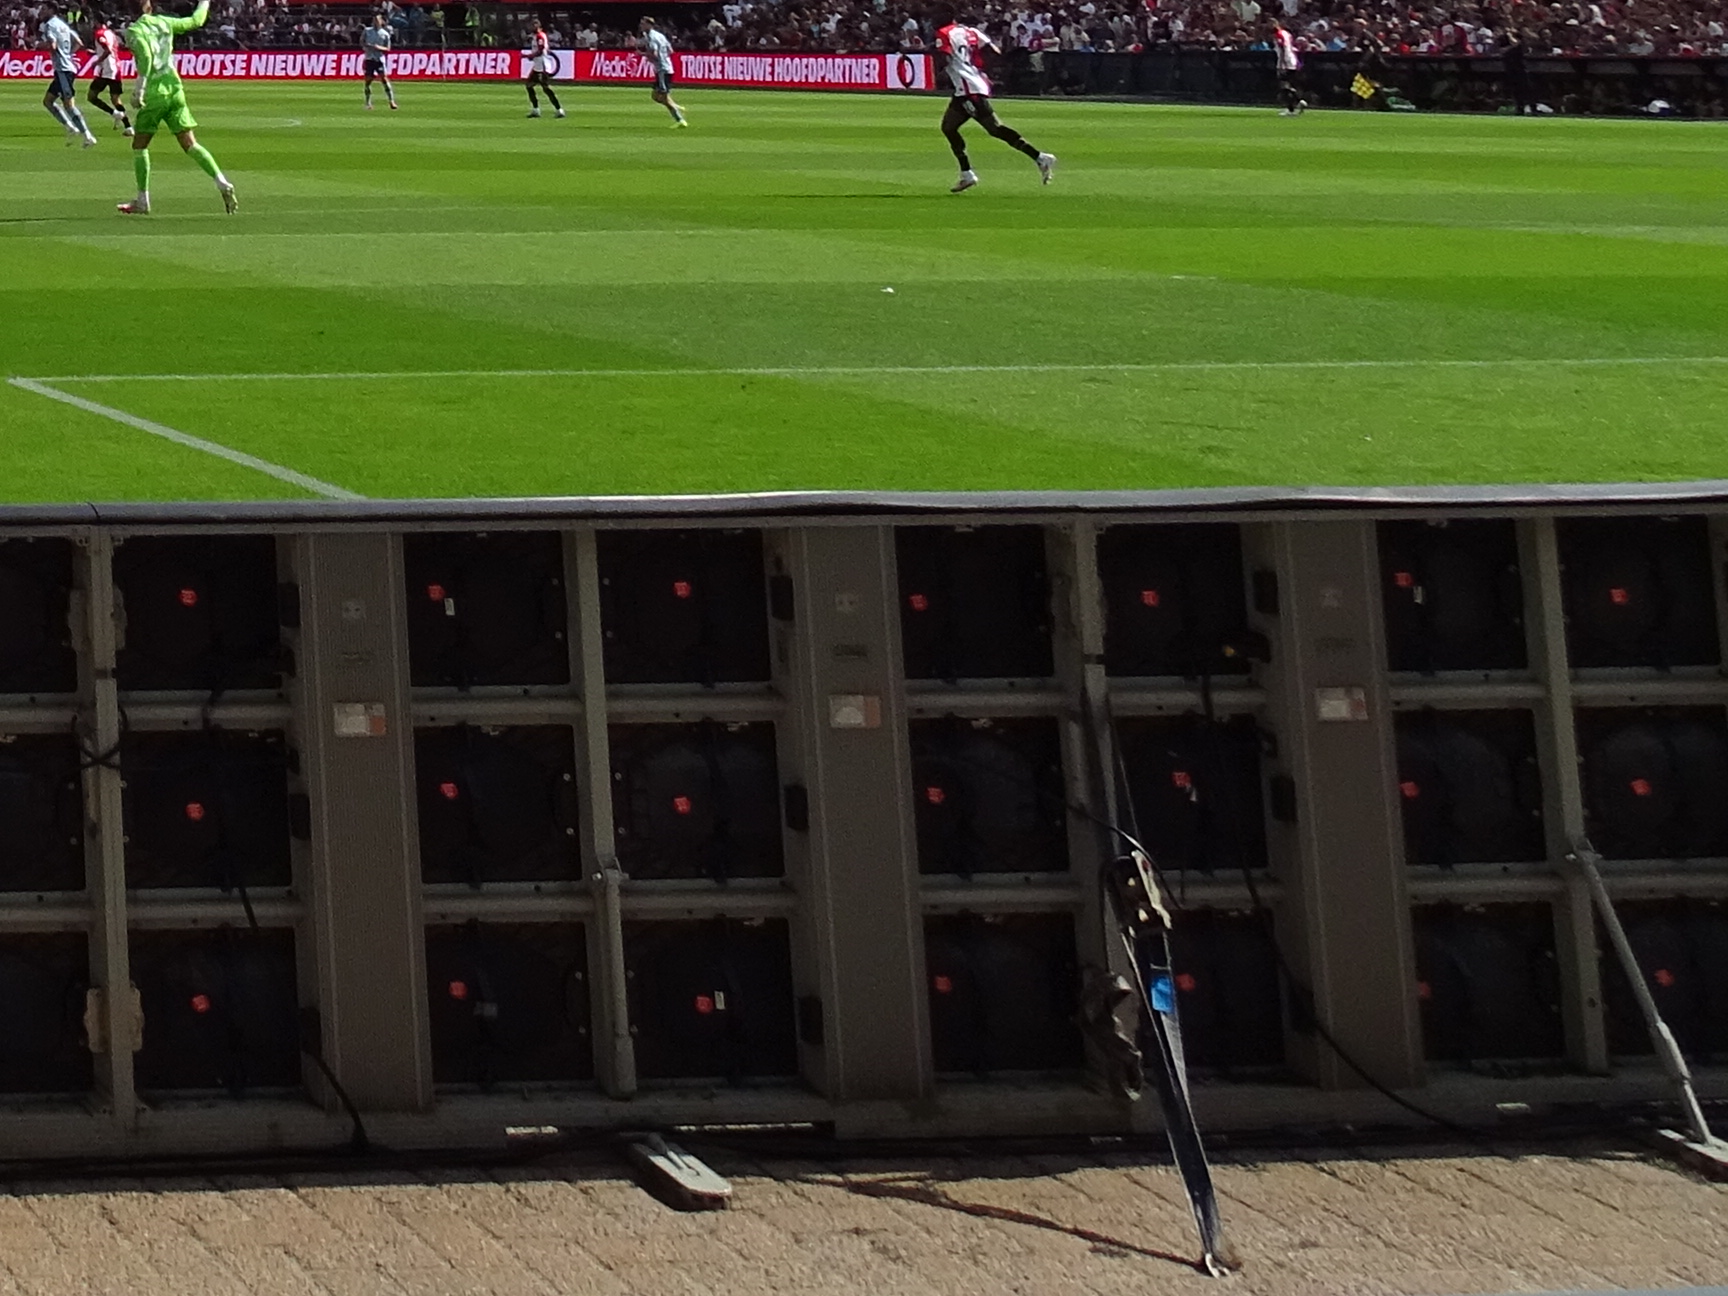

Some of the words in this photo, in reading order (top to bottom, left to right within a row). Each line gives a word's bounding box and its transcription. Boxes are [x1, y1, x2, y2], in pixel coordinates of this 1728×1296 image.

[250, 54, 337, 76] NIEUWE
[680, 55, 723, 79] TROTSE
[724, 56, 771, 81] NIEUWE
[773, 57, 879, 84] HOOFDPARTNER
